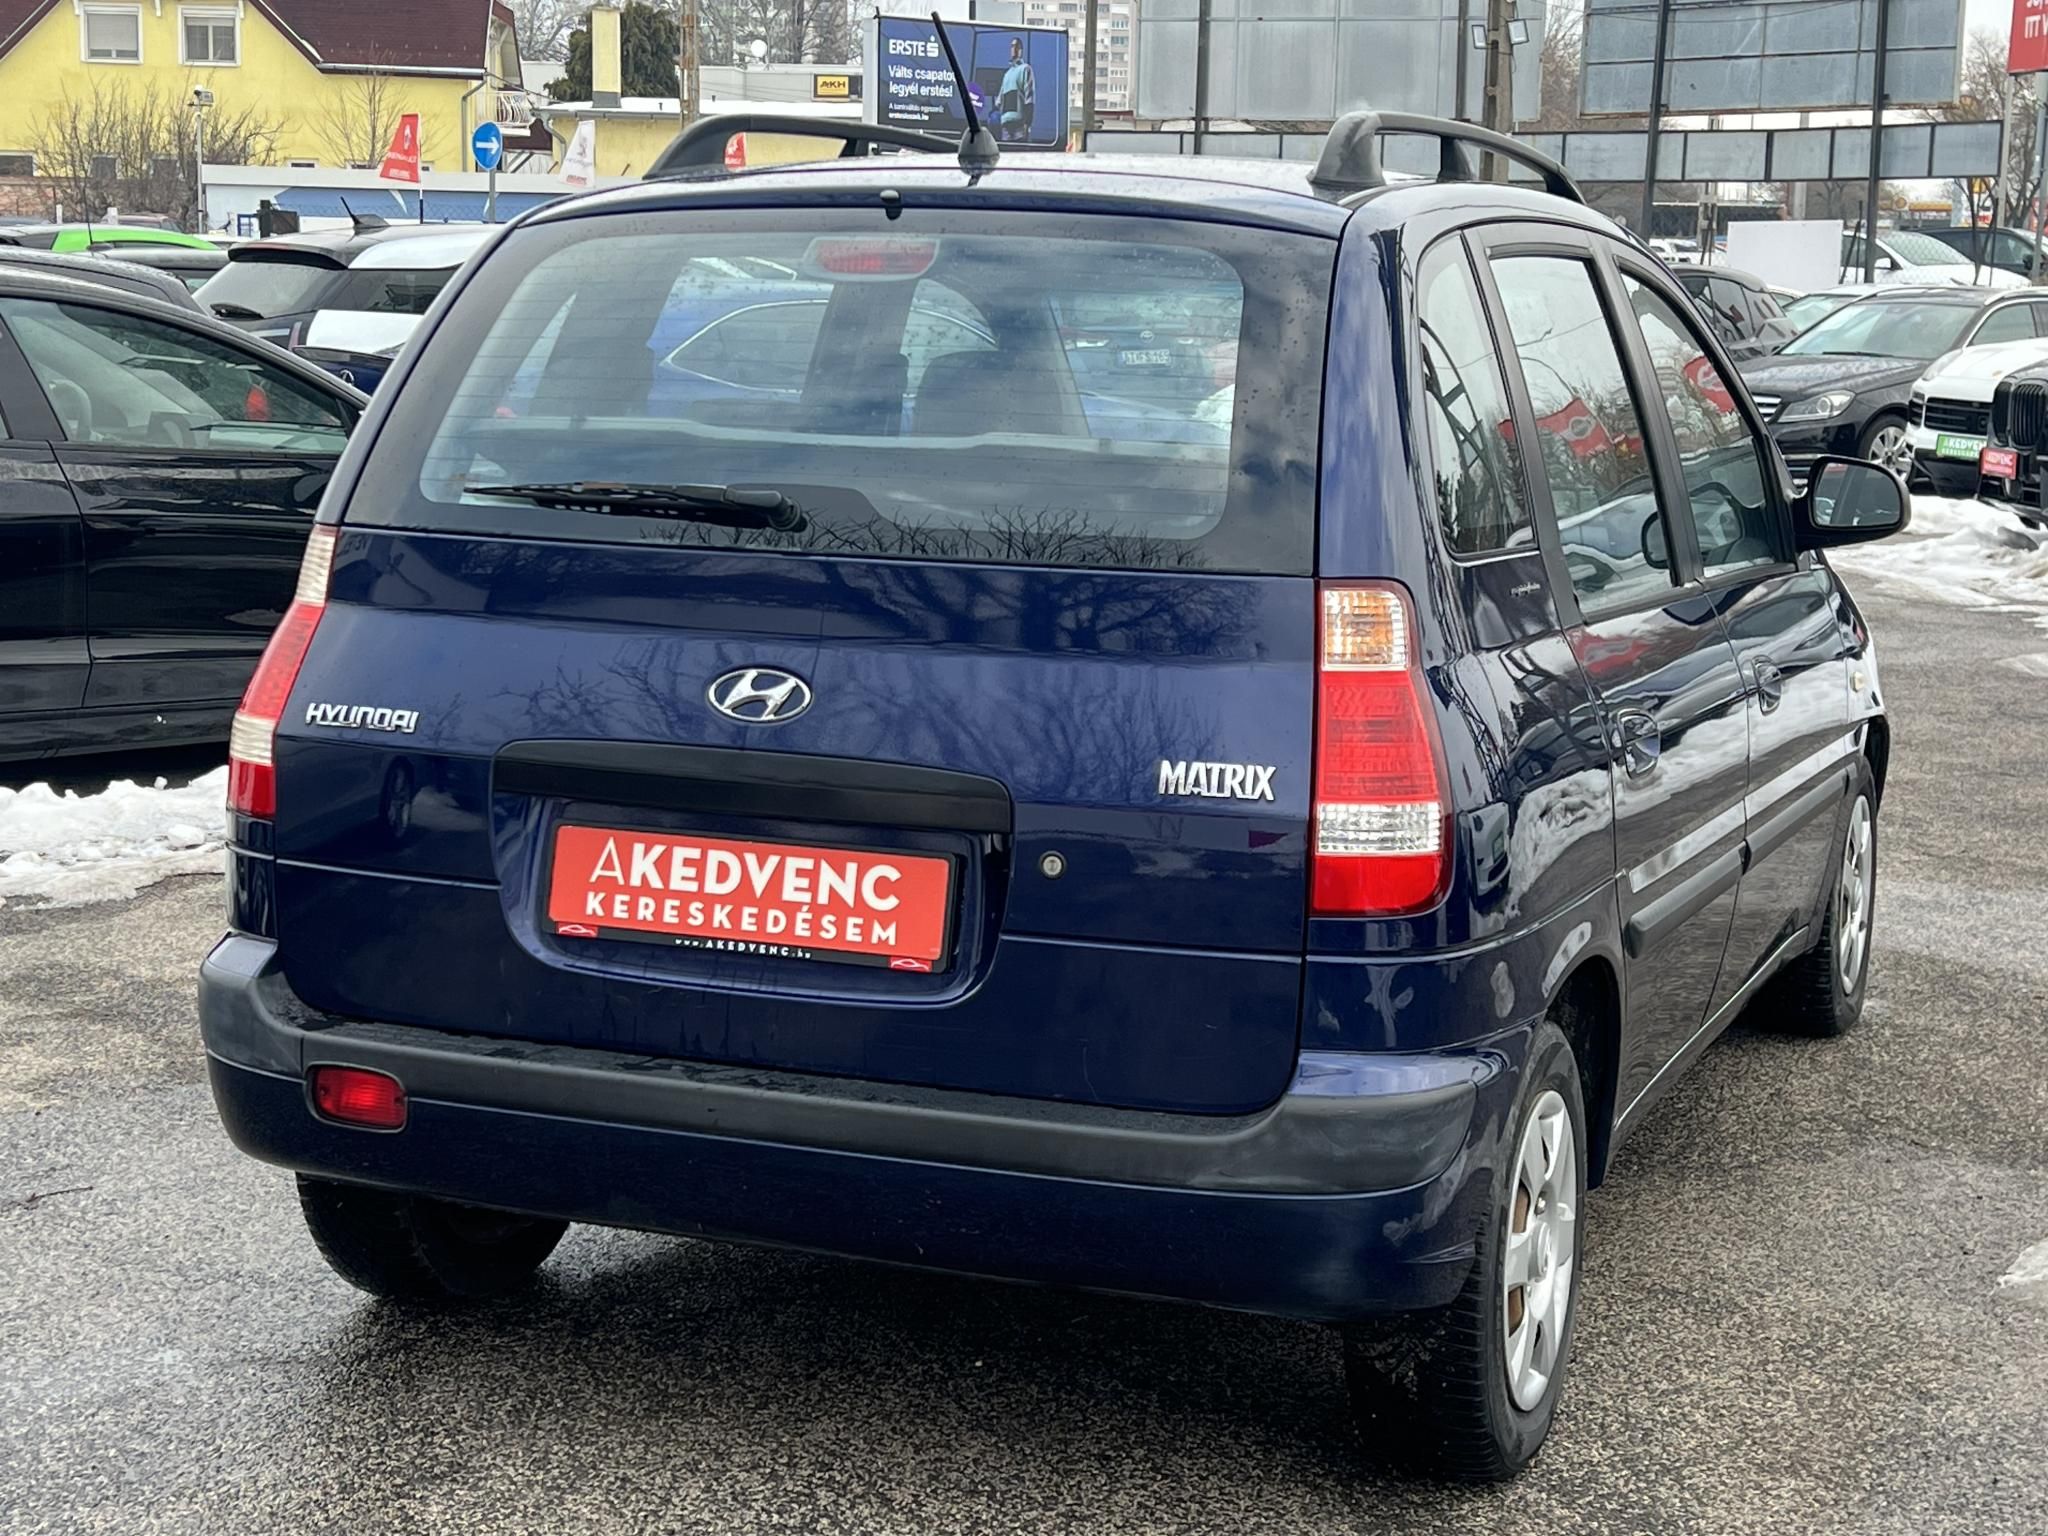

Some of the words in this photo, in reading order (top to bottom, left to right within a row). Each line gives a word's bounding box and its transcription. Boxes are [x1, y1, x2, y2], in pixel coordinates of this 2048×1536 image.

[889, 39, 926, 57] ERSTE
[888, 64, 913, 79] Válts
[914, 68, 956, 83] csapato
[889, 81, 918, 97] legyél
[920, 84, 953, 97] erstés!
[305, 702, 420, 734] HYUNDAI
[1158, 759, 1277, 801] MATRIX
[589, 836, 903, 912] AKEDVENC
[585, 890, 898, 947] KERESKEDÉSEM
[674, 938, 812, 960] www.AKEDVENC.hu
